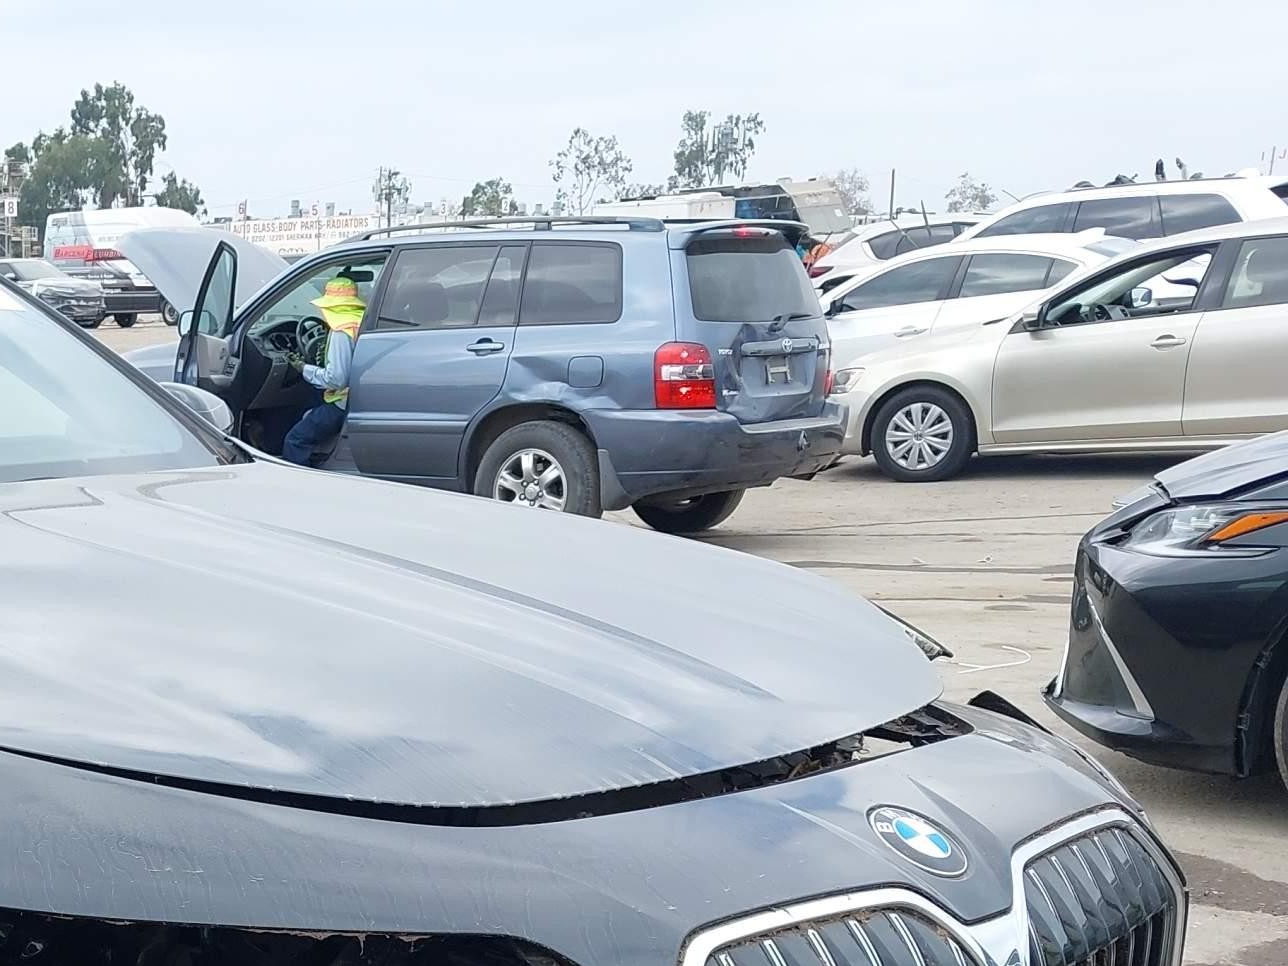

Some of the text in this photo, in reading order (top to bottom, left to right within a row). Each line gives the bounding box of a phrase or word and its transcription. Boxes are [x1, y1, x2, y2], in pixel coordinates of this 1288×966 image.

[7, 201, 14, 214] 8
[238, 203, 245, 215] 6
[311, 204, 318, 216] 5
[233, 223, 251, 234] AUTO
